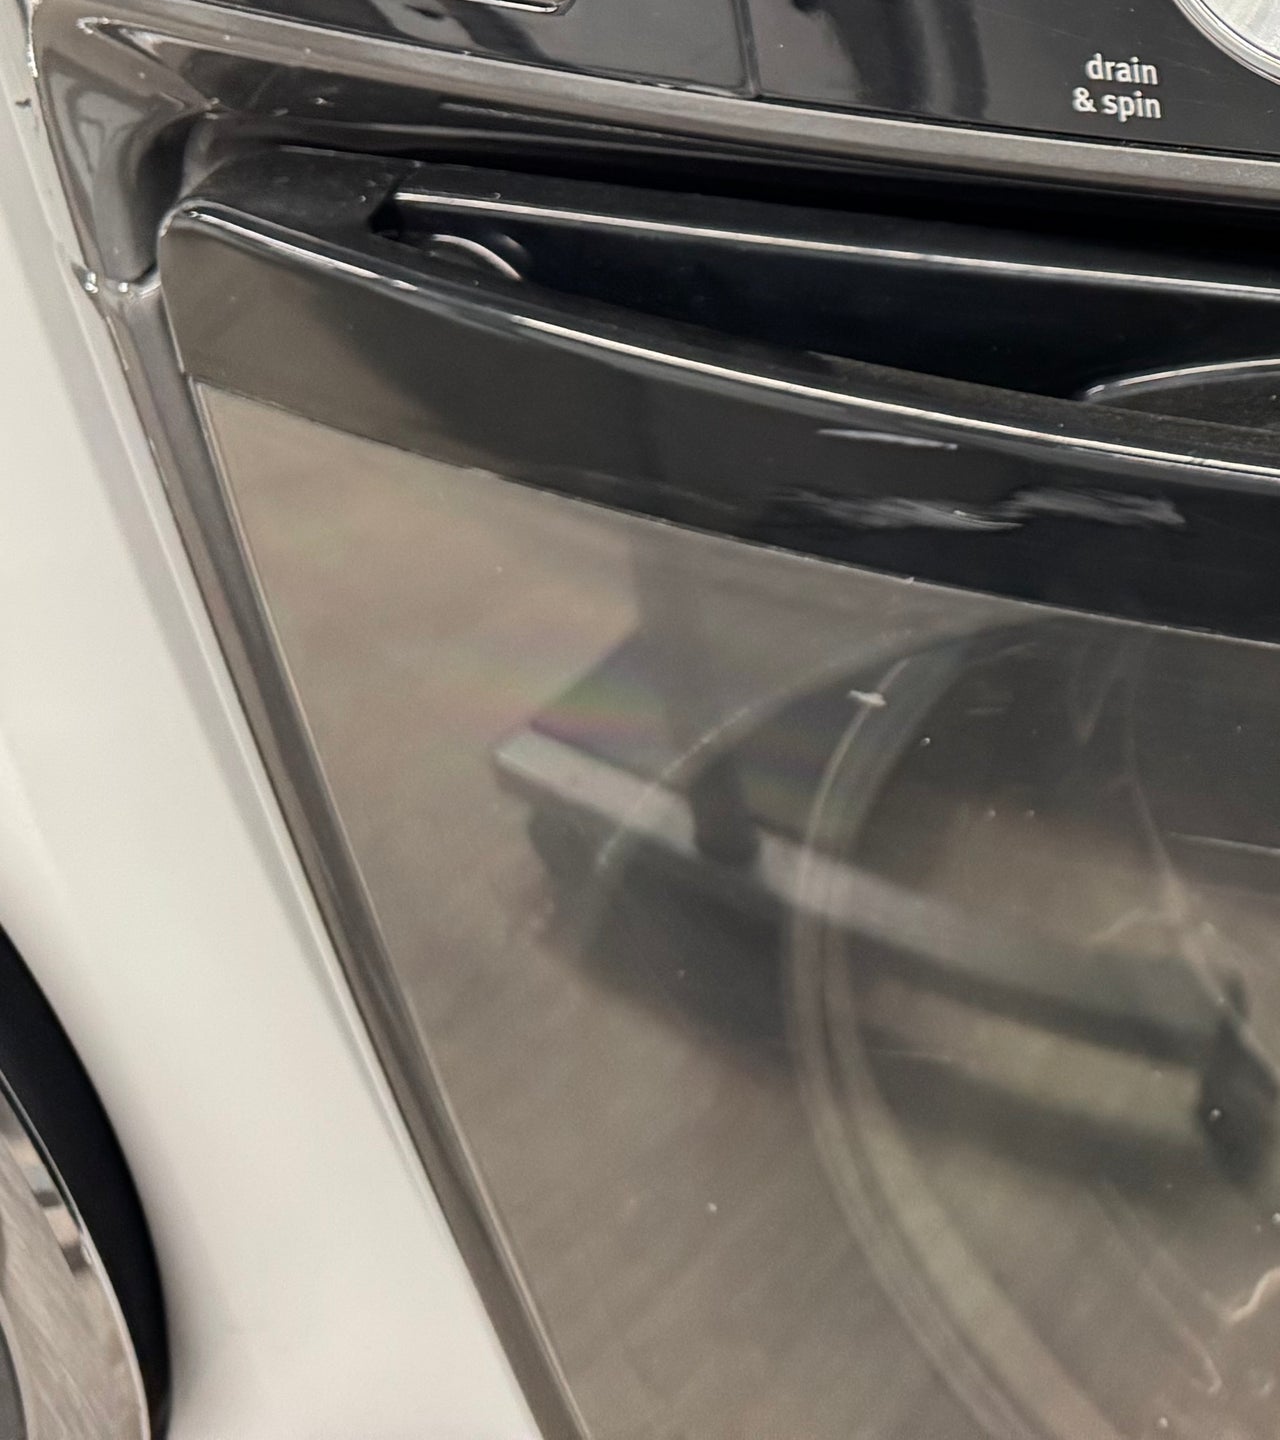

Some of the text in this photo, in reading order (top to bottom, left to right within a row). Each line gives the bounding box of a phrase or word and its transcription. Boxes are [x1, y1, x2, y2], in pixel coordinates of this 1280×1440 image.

[1086, 52, 1158, 85] drain
[1073, 87, 1162, 122] & spin
